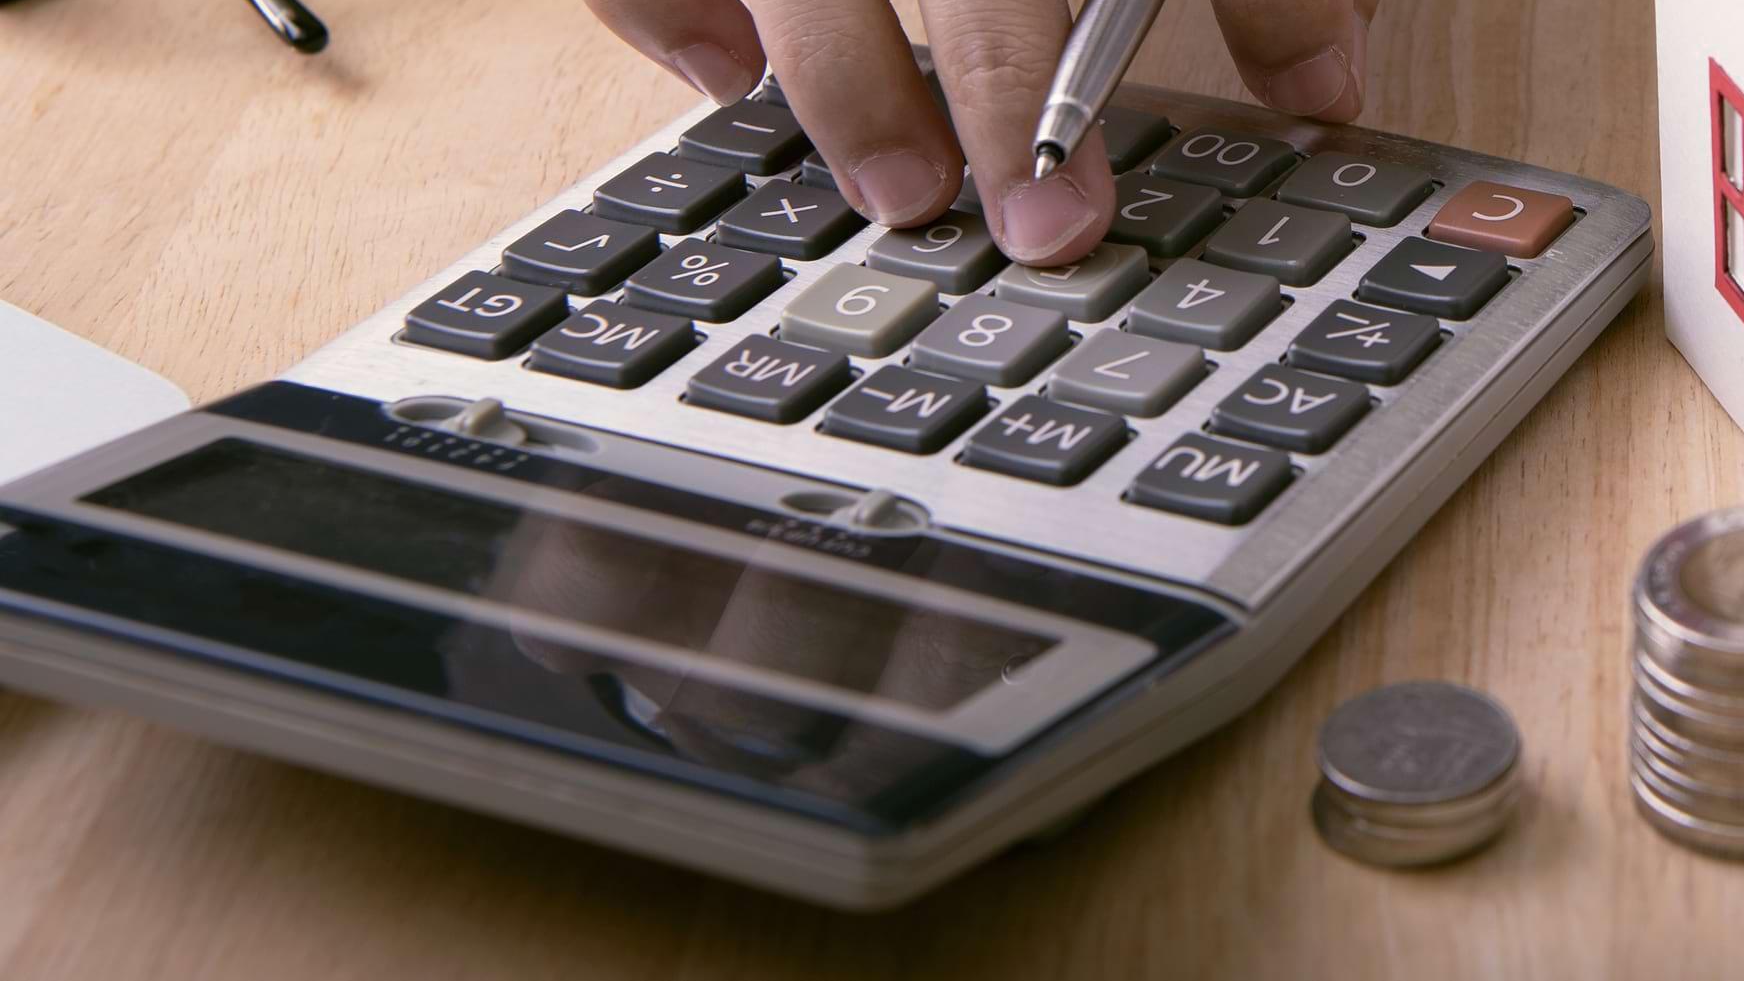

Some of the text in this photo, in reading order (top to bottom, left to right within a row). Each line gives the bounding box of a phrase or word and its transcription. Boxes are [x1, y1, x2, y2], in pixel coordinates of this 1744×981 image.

[1181, 134, 1260, 166] 00
[1332, 163, 1377, 187] 0
[1120, 188, 1174, 221] 2
[1471, 194, 1524, 221] C
[911, 224, 964, 255] 6
[1257, 216, 1290, 245] 1
[670, 255, 730, 287] %
[436, 287, 522, 318] GT
[835, 285, 890, 315] 9
[1176, 278, 1227, 310] 4
[559, 313, 661, 351] MC
[958, 314, 1013, 347] 8
[723, 348, 819, 387] MR
[1093, 351, 1150, 379] 7
[1242, 377, 1337, 415] AC
[1000, 412, 1094, 451] M+
[1155, 445, 1261, 487] MU
